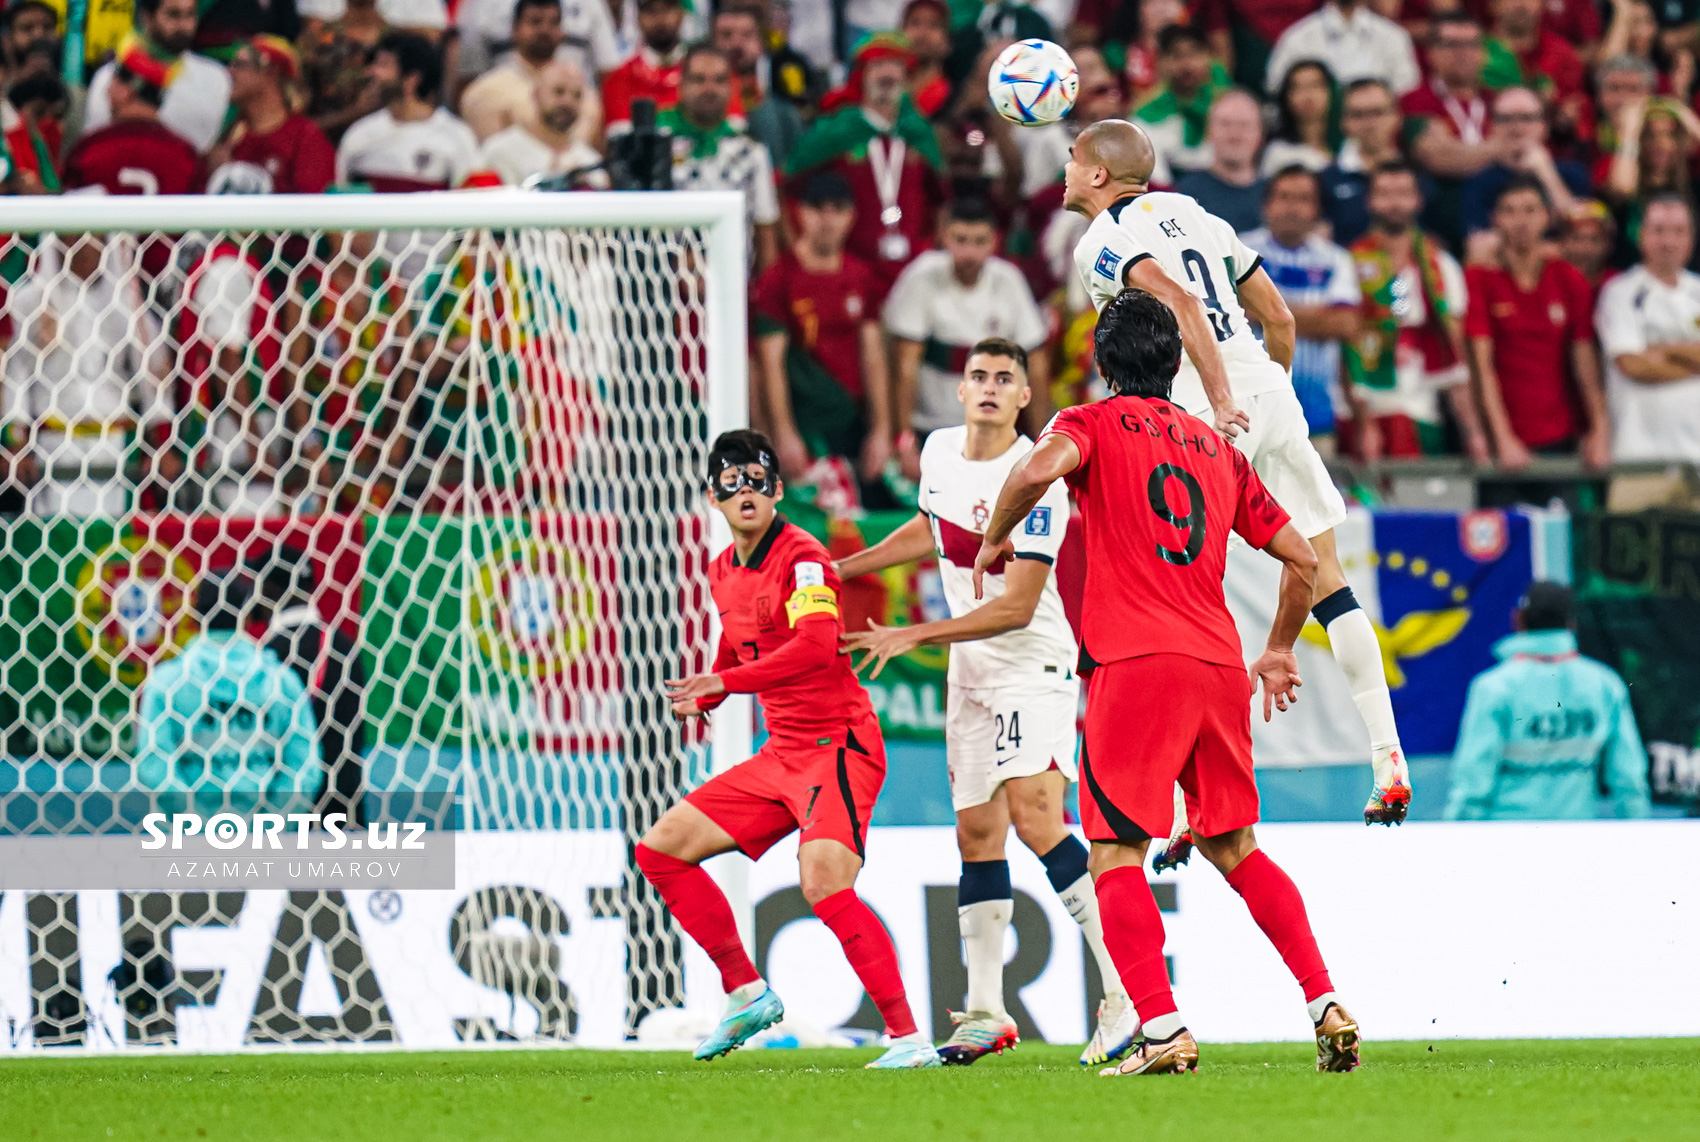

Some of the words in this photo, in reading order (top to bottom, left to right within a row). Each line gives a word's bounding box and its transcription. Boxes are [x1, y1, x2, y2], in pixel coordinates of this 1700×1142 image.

[1120, 413, 1141, 433] G
[1145, 417, 1161, 438] S
[1167, 423, 1217, 458] CHO
[1147, 462, 1207, 566] 9
[994, 710, 1023, 752] 24
[806, 785, 823, 819] 7
